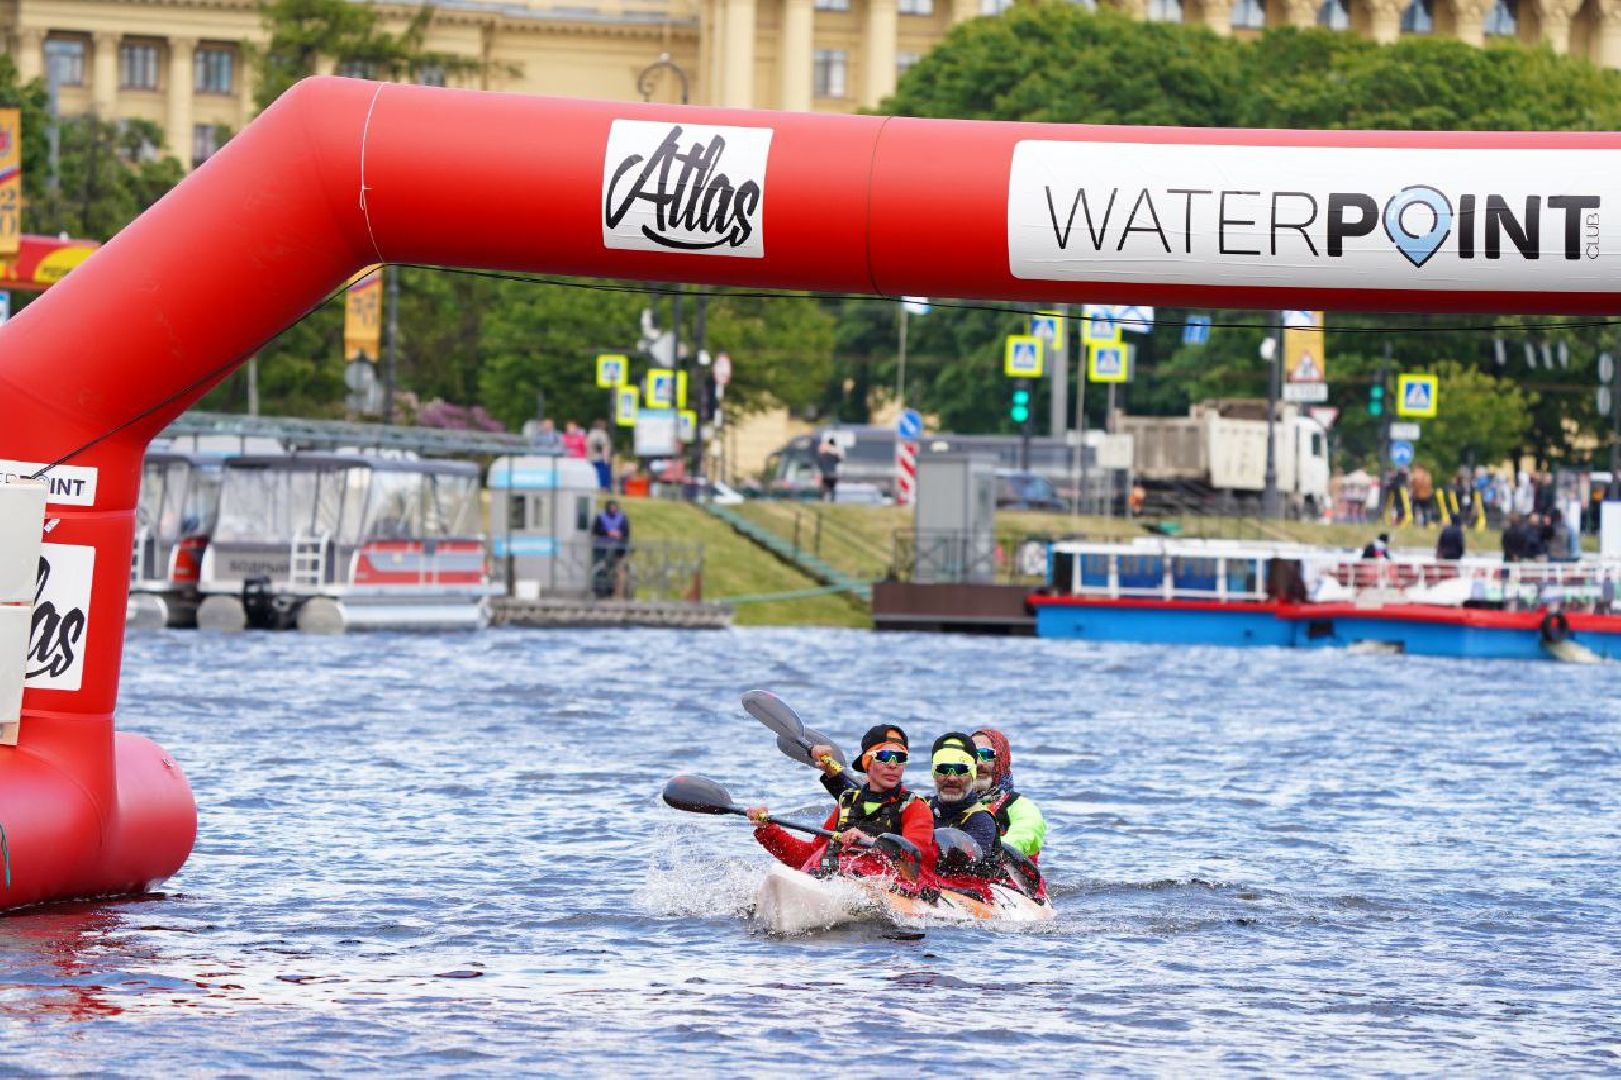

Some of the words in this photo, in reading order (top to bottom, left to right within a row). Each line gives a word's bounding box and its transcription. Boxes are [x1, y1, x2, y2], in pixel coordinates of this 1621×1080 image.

[606, 125, 760, 249] Atlas
[1045, 185, 1600, 267] WATERPOINT
[1585, 212, 1600, 260] CLUB
